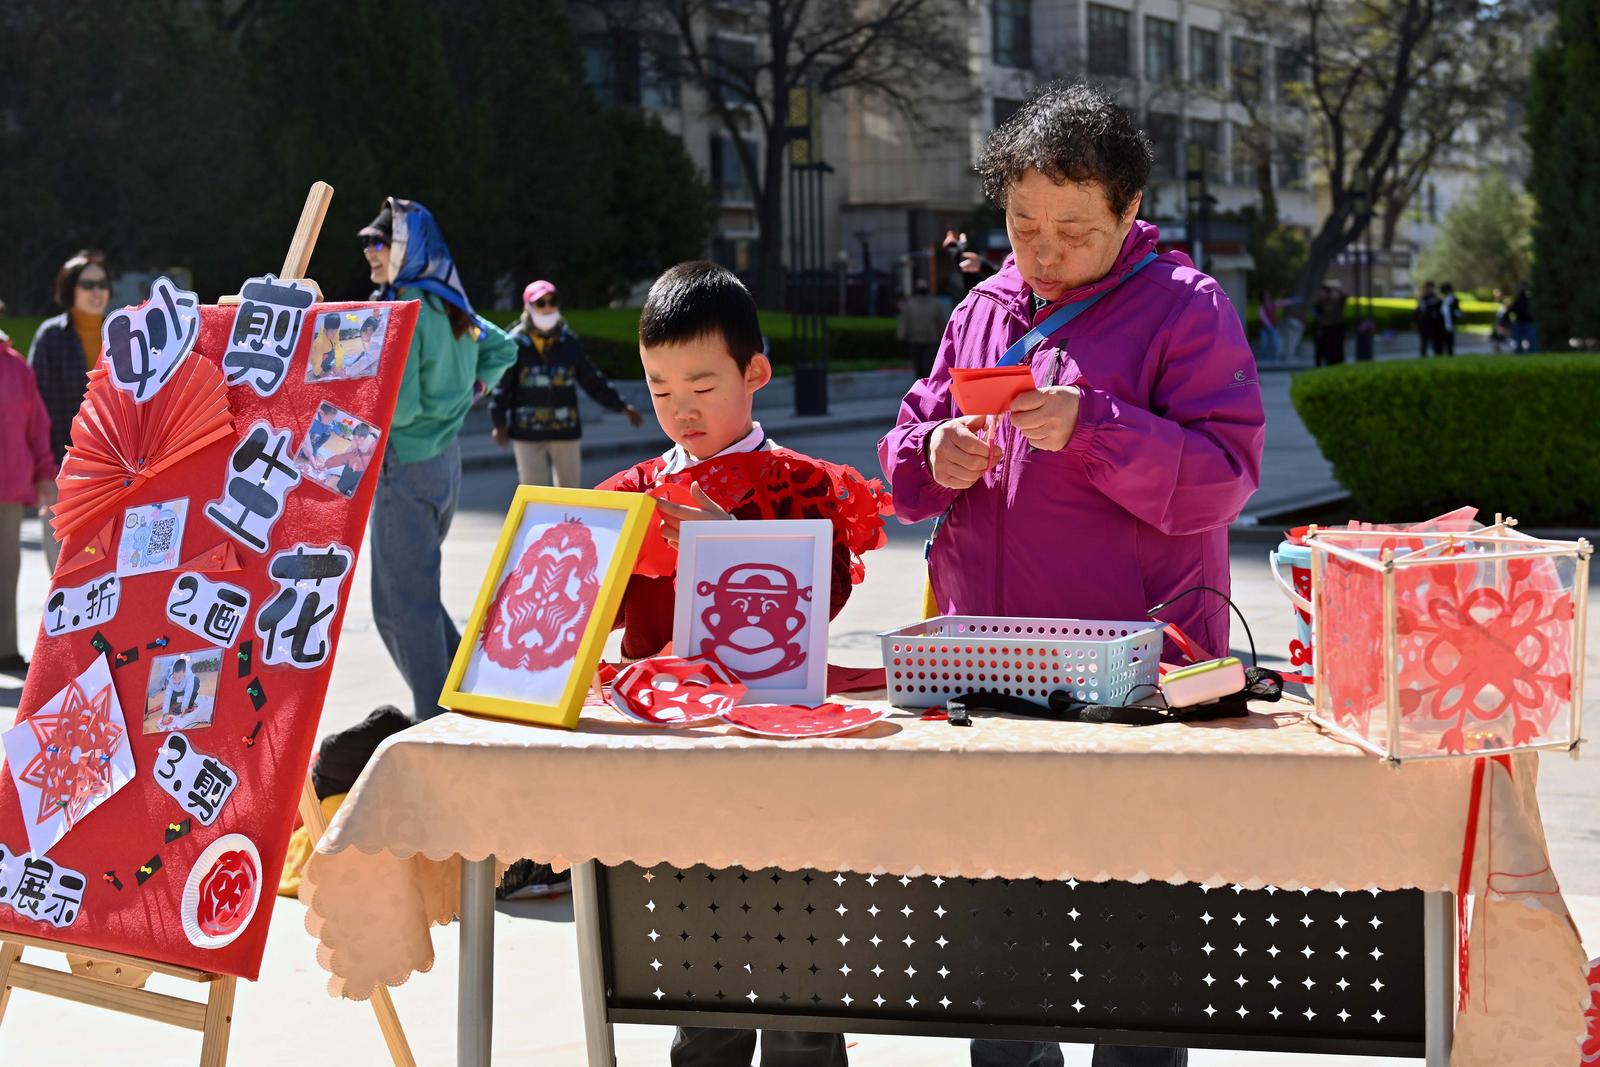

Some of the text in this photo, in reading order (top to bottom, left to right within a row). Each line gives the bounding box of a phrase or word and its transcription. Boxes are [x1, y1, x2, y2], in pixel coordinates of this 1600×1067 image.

[48, 576, 115, 632] 1.折
[171, 575, 247, 643] 2.画
[159, 735, 231, 820] 3.剪
[0, 850, 83, 923] .展示
